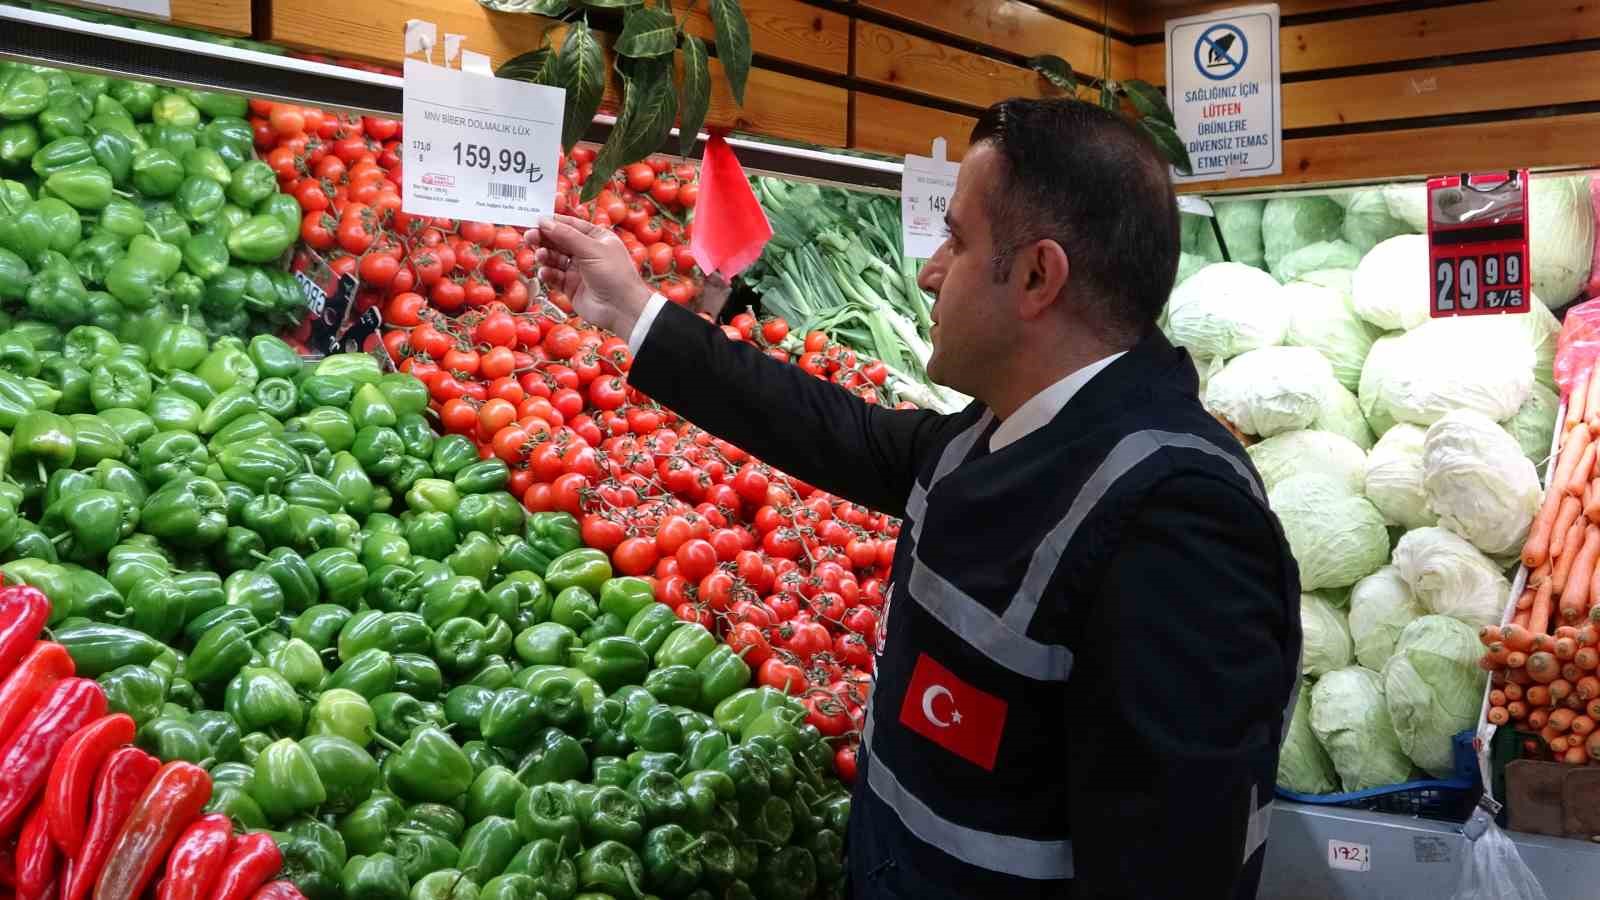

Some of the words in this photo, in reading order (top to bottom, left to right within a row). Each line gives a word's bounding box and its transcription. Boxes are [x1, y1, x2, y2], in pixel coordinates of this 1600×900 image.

[1240, 81, 1259, 98] İÇİN
[1203, 102, 1241, 118] LÜTFEN
[1198, 119, 1247, 136] ÜRÜNLERE
[1236, 135, 1268, 148] TEMAS
[1437, 259, 1477, 310] 29
[1485, 255, 1519, 284] 99
